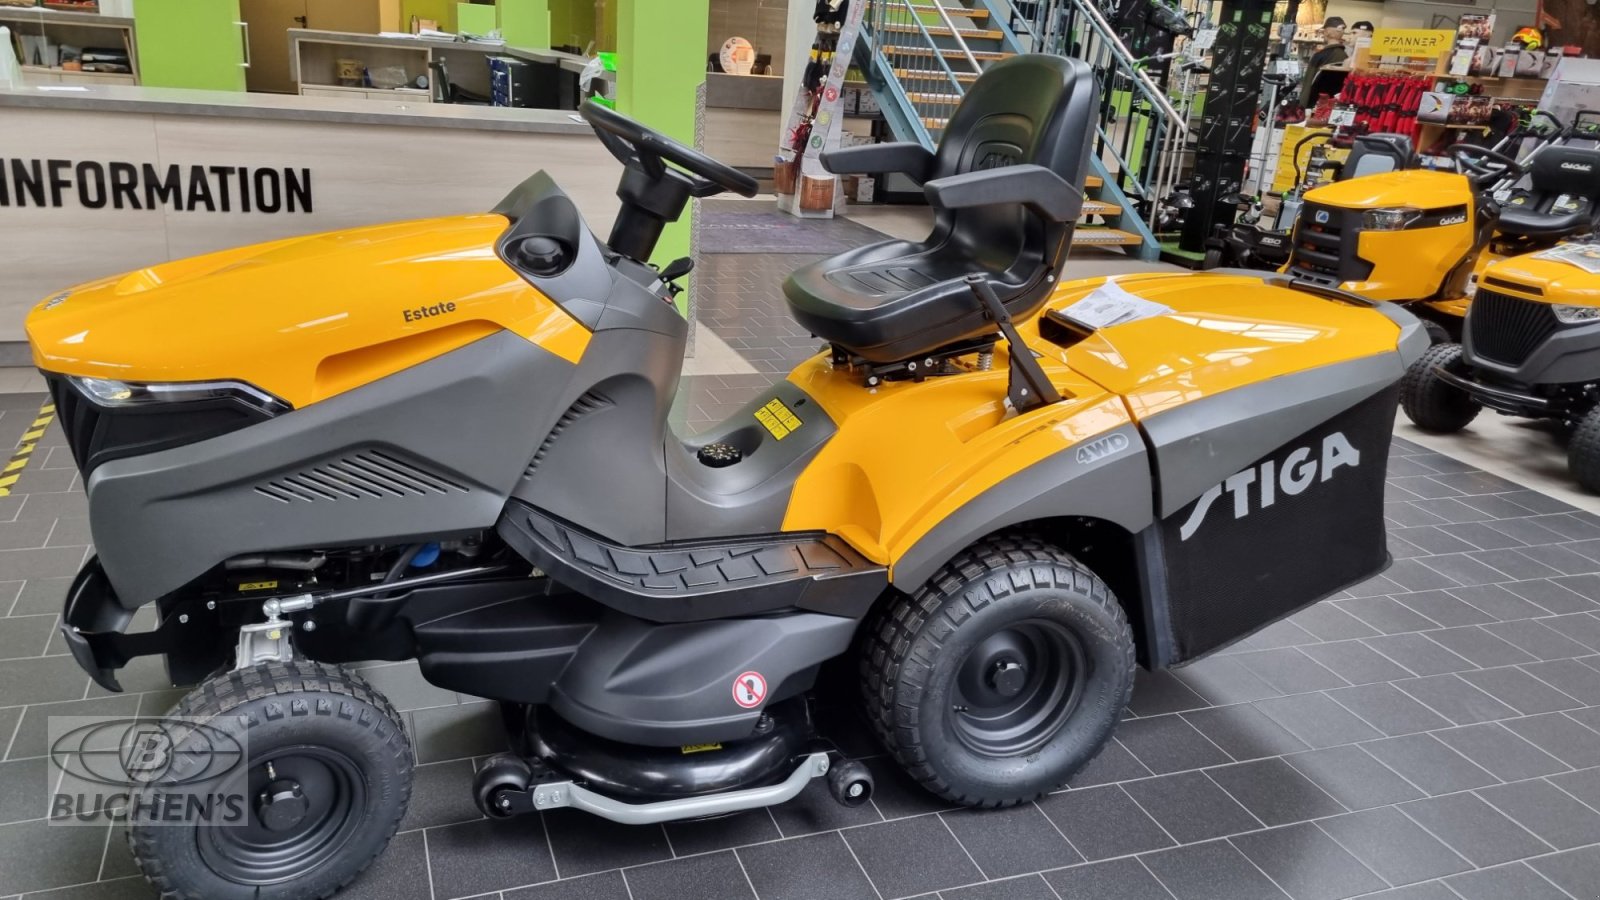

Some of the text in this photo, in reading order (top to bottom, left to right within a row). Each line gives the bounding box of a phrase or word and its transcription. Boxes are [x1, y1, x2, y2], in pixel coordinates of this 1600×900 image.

[1383, 36, 1437, 47] PFANNER
[0, 158, 313, 213] INFORMATION
[402, 301, 456, 323] Estate
[1077, 434, 1127, 463] 4WD
